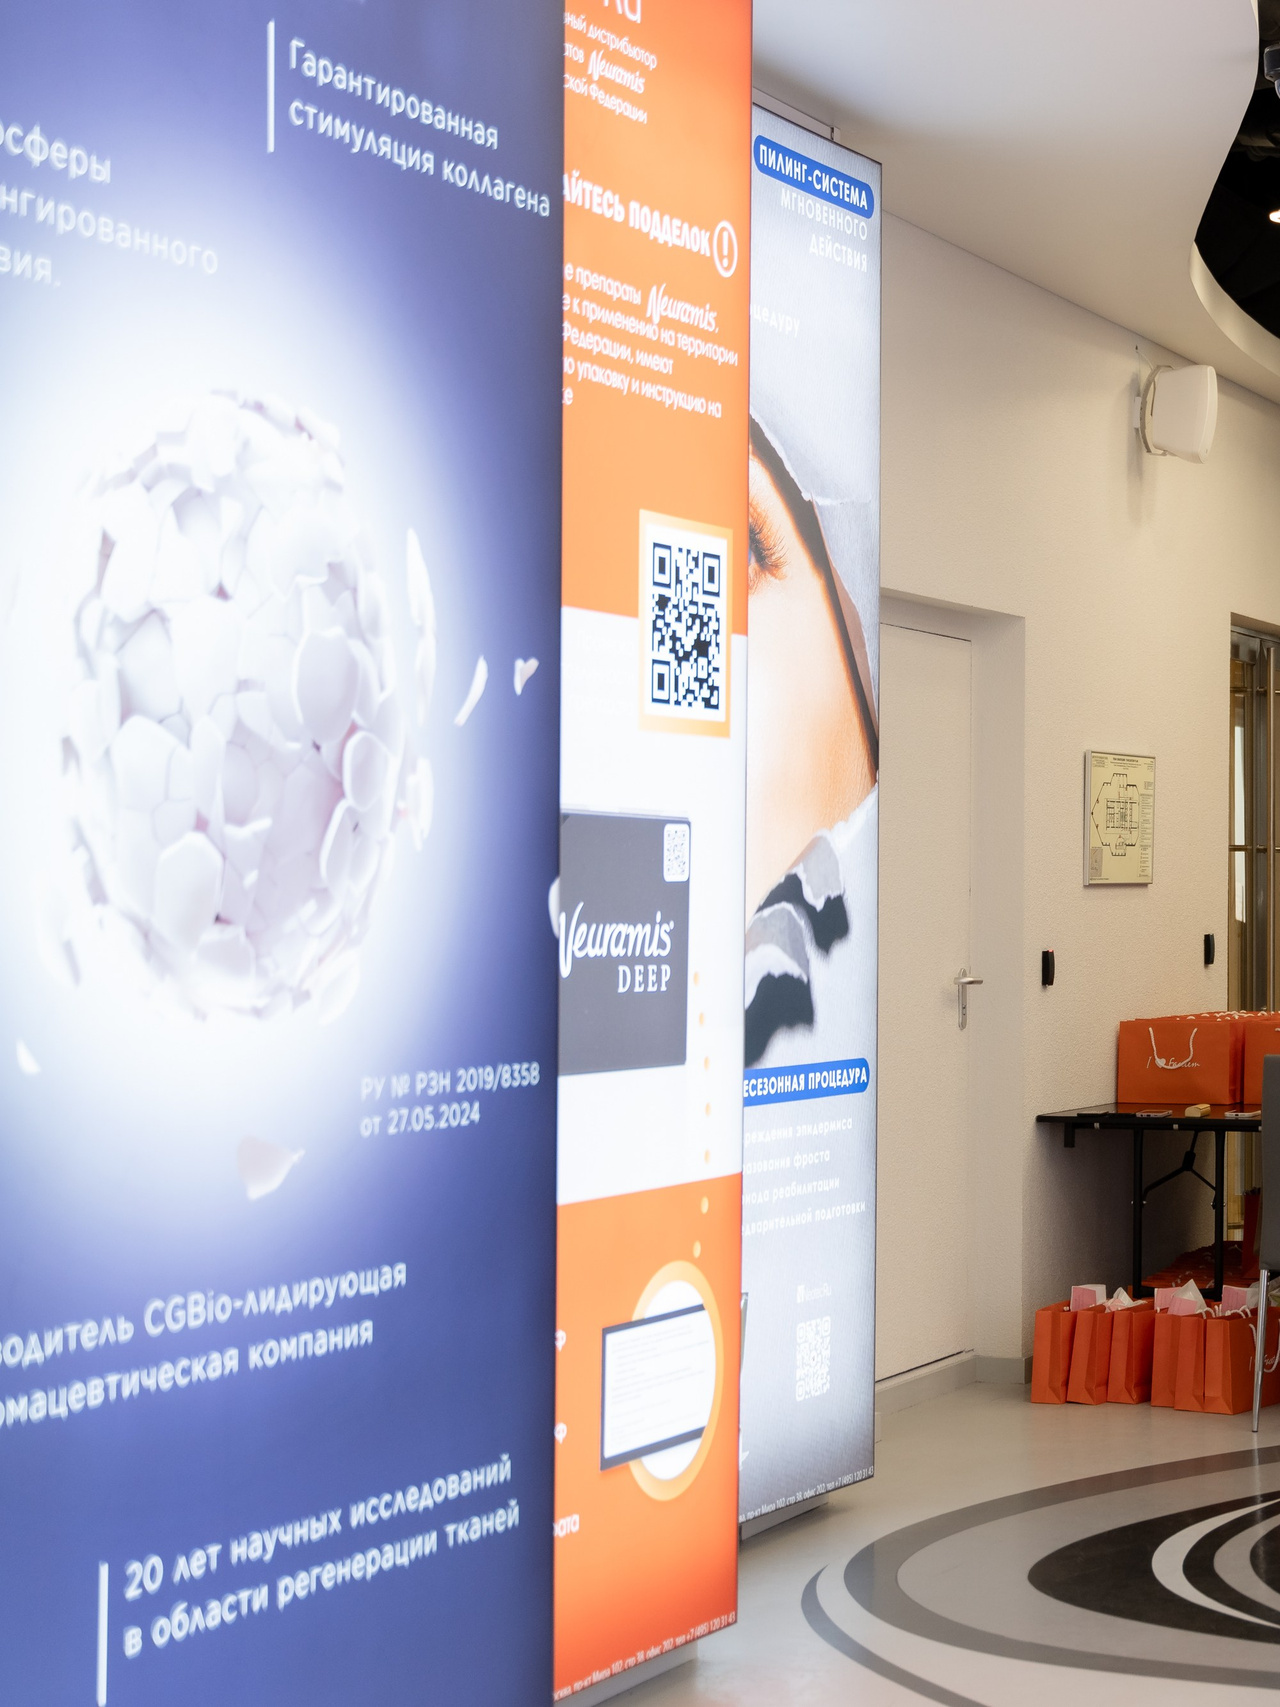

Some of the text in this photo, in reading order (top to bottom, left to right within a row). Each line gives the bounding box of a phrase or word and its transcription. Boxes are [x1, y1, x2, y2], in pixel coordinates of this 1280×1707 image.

[587, 24, 657, 71] дистрибьютор
[289, 37, 498, 150] Гарантированная
[587, 49, 646, 94] Neuramis
[589, 83, 648, 124] Федерации
[0, 118, 111, 184] сферы
[289, 97, 550, 217] стимуляция коллагена
[759, 143, 868, 211] ПИЛИНГ-СИСТЕМА
[628, 199, 711, 257] ПОДДЕЛОК
[780, 187, 868, 241] МГНОВЕННОГО
[809, 234, 868, 273] ДЕЙСТВИЯ
[575, 266, 642, 306] препараты
[572, 297, 581, 315] к
[581, 300, 659, 342] применению
[660, 326, 676, 348] на
[676, 332, 738, 367] территории
[749, 301, 801, 338] цедуру
[635, 348, 674, 376] имеют
[577, 360, 631, 396] упаковку
[631, 379, 641, 394] и
[641, 380, 707, 415] инструкцию
[707, 401, 722, 418] на
[617, 964, 672, 994] DEEP
[360, 1075, 386, 1101] РУ
[390, 1072, 410, 1099] №
[456, 1061, 541, 1093] 2019/8358
[808, 1066, 867, 1091] ПРОЦЕДУРА
[359, 1099, 481, 1138] от 27.05.2024
[796, 1118, 853, 1137] эпидермиса
[793, 1149, 831, 1169] фроста
[772, 1177, 840, 1203] реабилитации
[815, 1200, 866, 1221] подготовки
[0, 1262, 407, 1371] одитель CGBio-лидирующая
[0, 1319, 373, 1429] мацевтическая компания
[124, 1452, 512, 1601] 20 лет научных исследований
[123, 1498, 520, 1658] в области регенерации тканей
